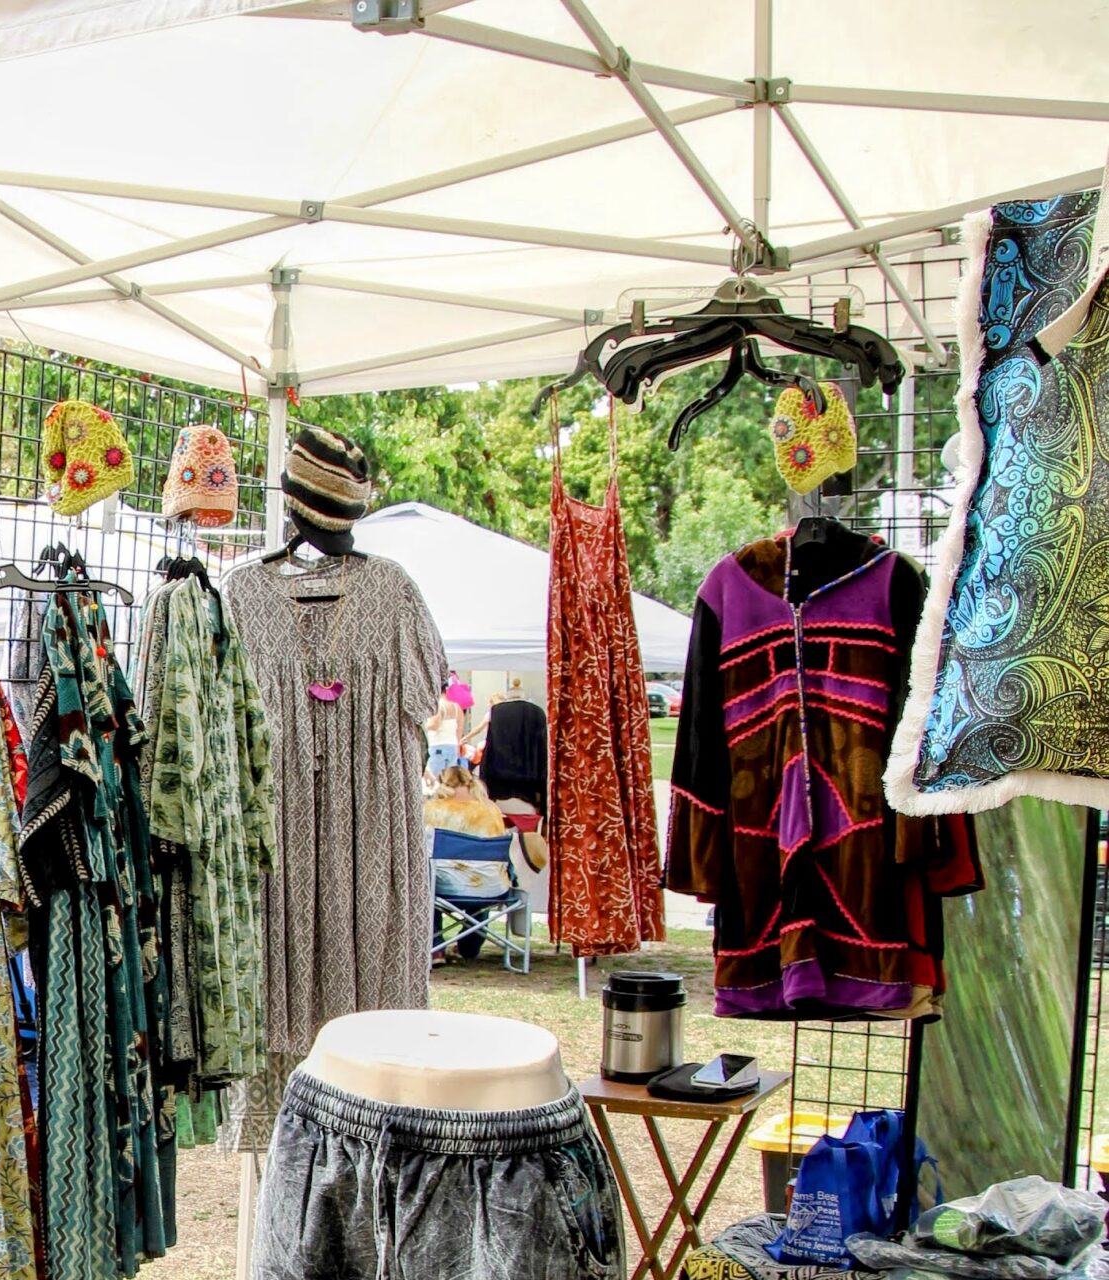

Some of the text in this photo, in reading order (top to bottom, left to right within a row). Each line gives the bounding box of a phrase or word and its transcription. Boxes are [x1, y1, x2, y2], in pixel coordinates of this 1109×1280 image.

[793, 1192, 815, 1201] ems
[794, 1239, 812, 1249] Fine
[813, 1241, 846, 1255] Jewelry
